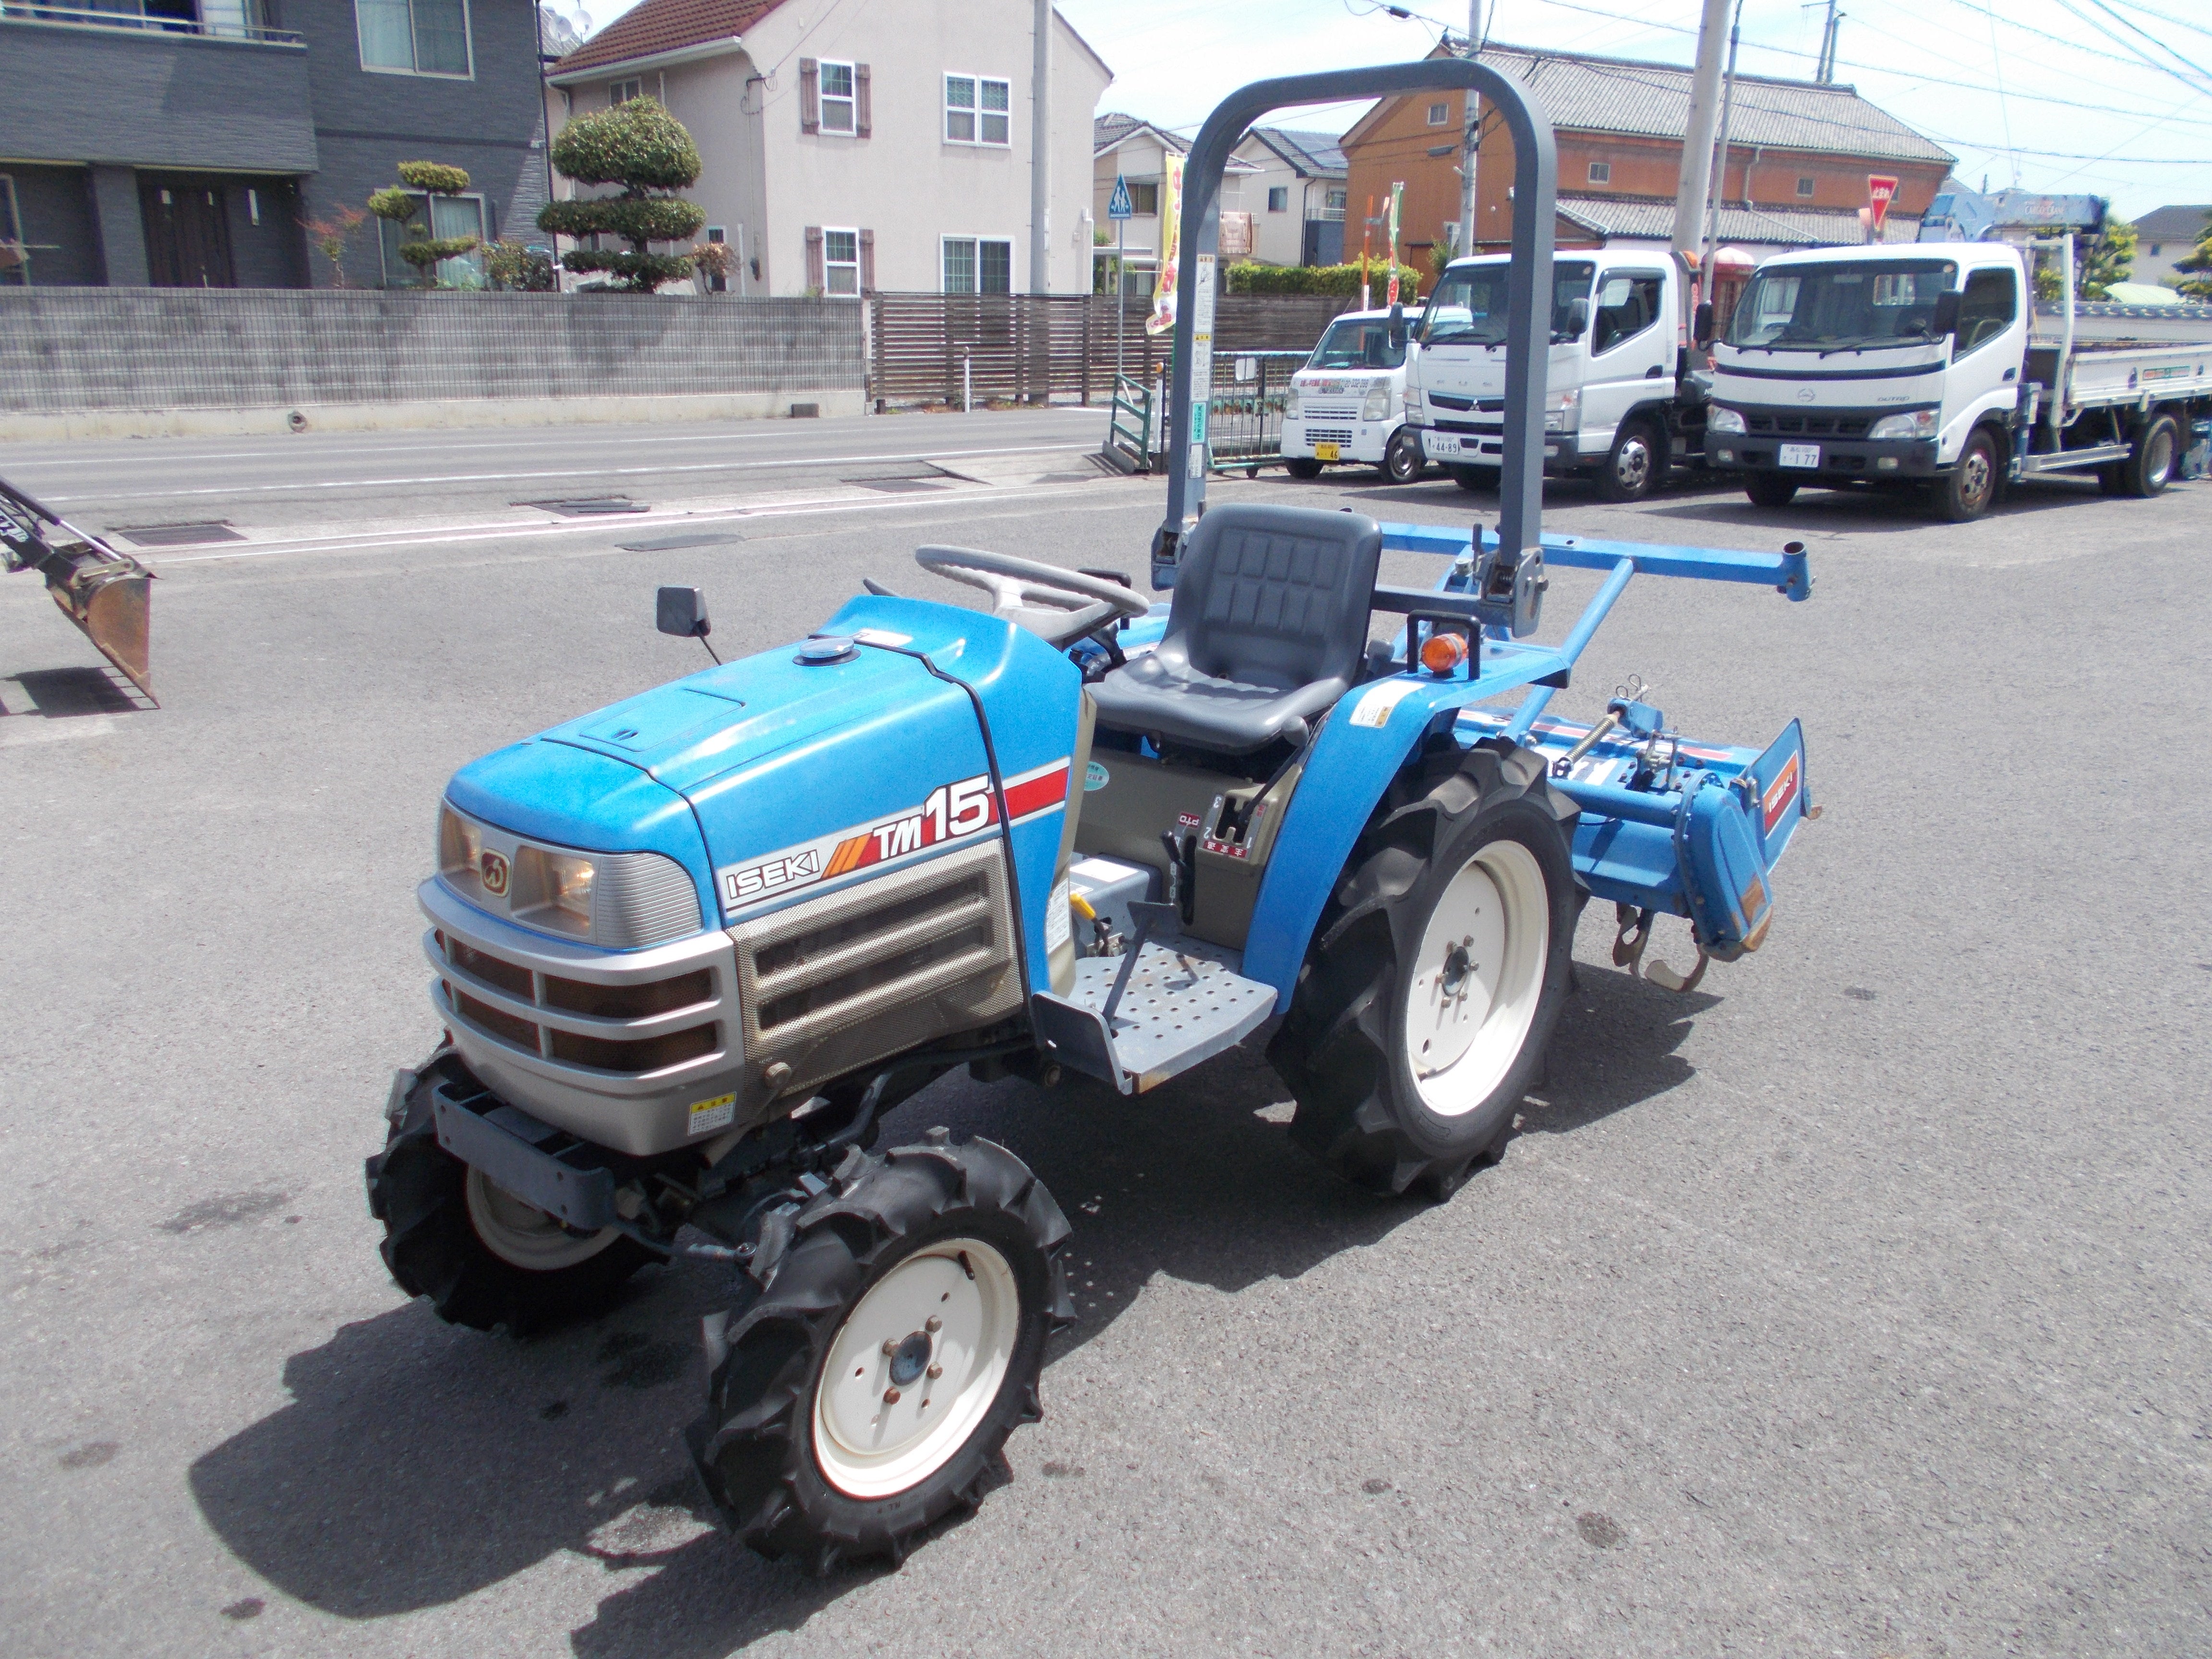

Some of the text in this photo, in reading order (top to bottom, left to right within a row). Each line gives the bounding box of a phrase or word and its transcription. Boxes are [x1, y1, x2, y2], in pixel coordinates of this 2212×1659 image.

[1872, 186, 1890, 199] 止まれ
[1769, 771, 1793, 813] ISEKI
[1214, 796, 1222, 808] 3
[1179, 815, 1200, 826] PTO
[1203, 827, 1212, 839] 2
[727, 849, 820, 899] ISEKI
